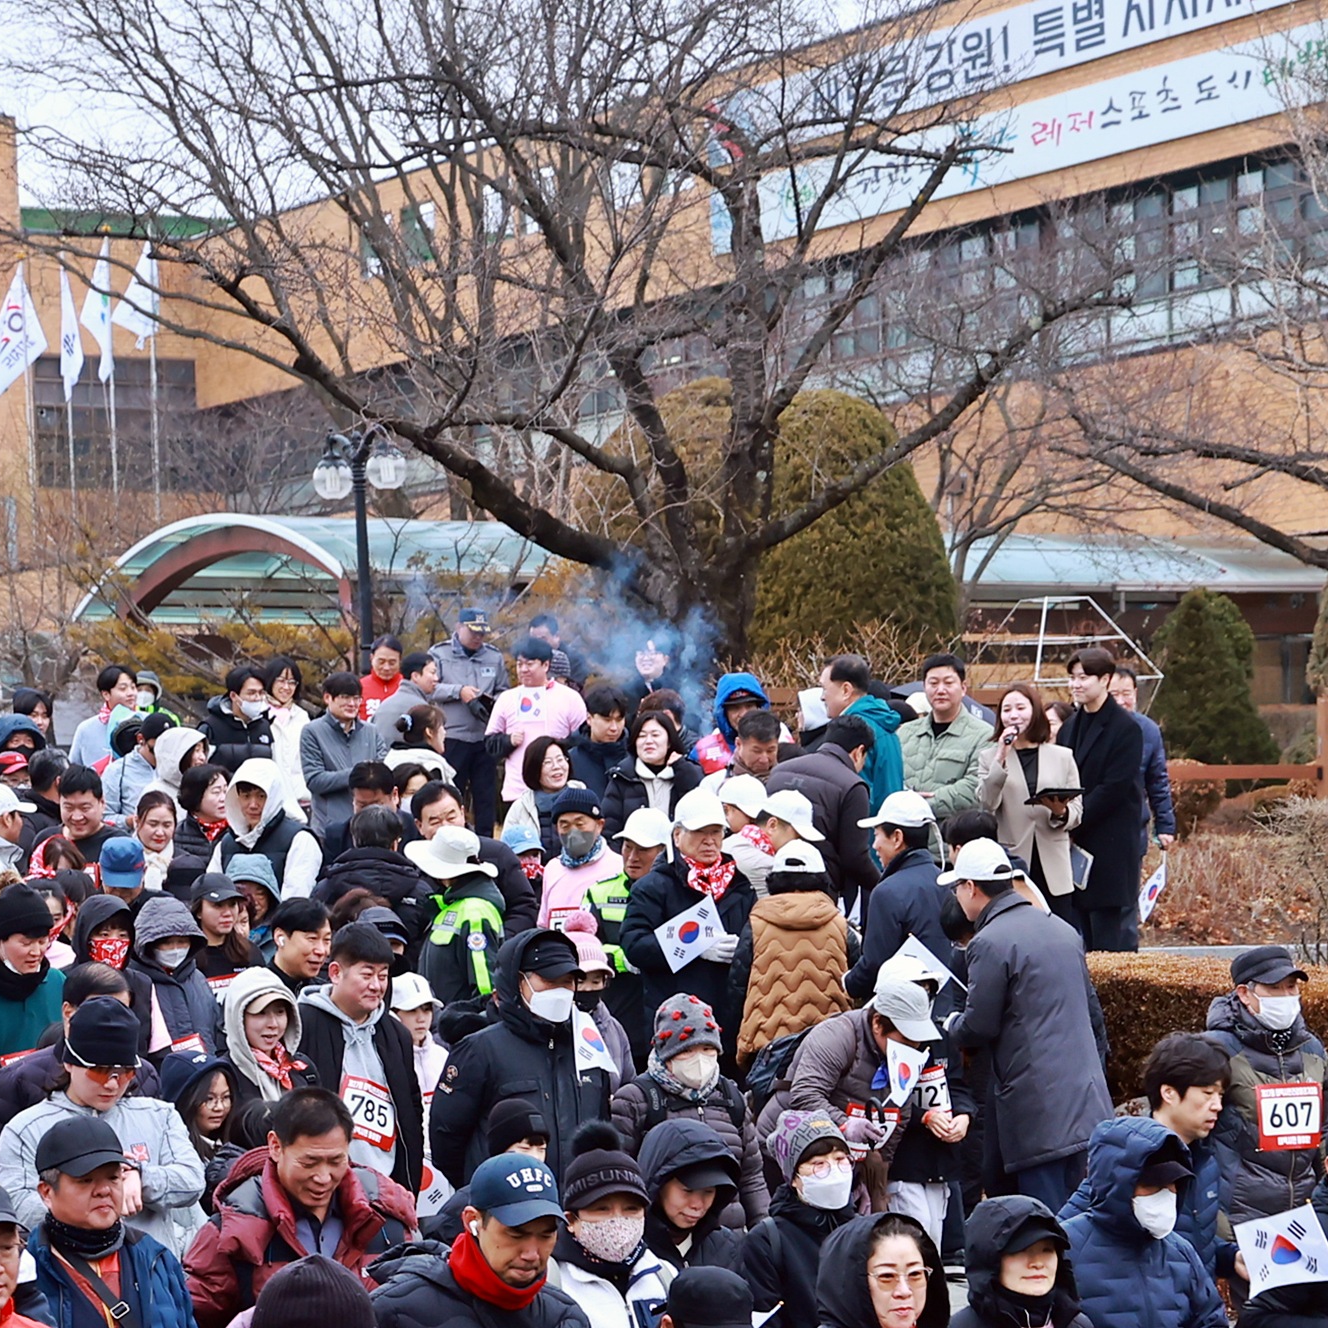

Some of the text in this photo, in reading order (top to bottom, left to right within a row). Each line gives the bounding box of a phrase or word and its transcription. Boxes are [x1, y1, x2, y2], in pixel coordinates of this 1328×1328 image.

[1033, 0, 1106, 57] 특별
[1195, 70, 1251, 105] 도시
[351, 1094, 387, 1127] 785
[1270, 1102, 1313, 1128] 607
[506, 1167, 552, 1188] UHFC
